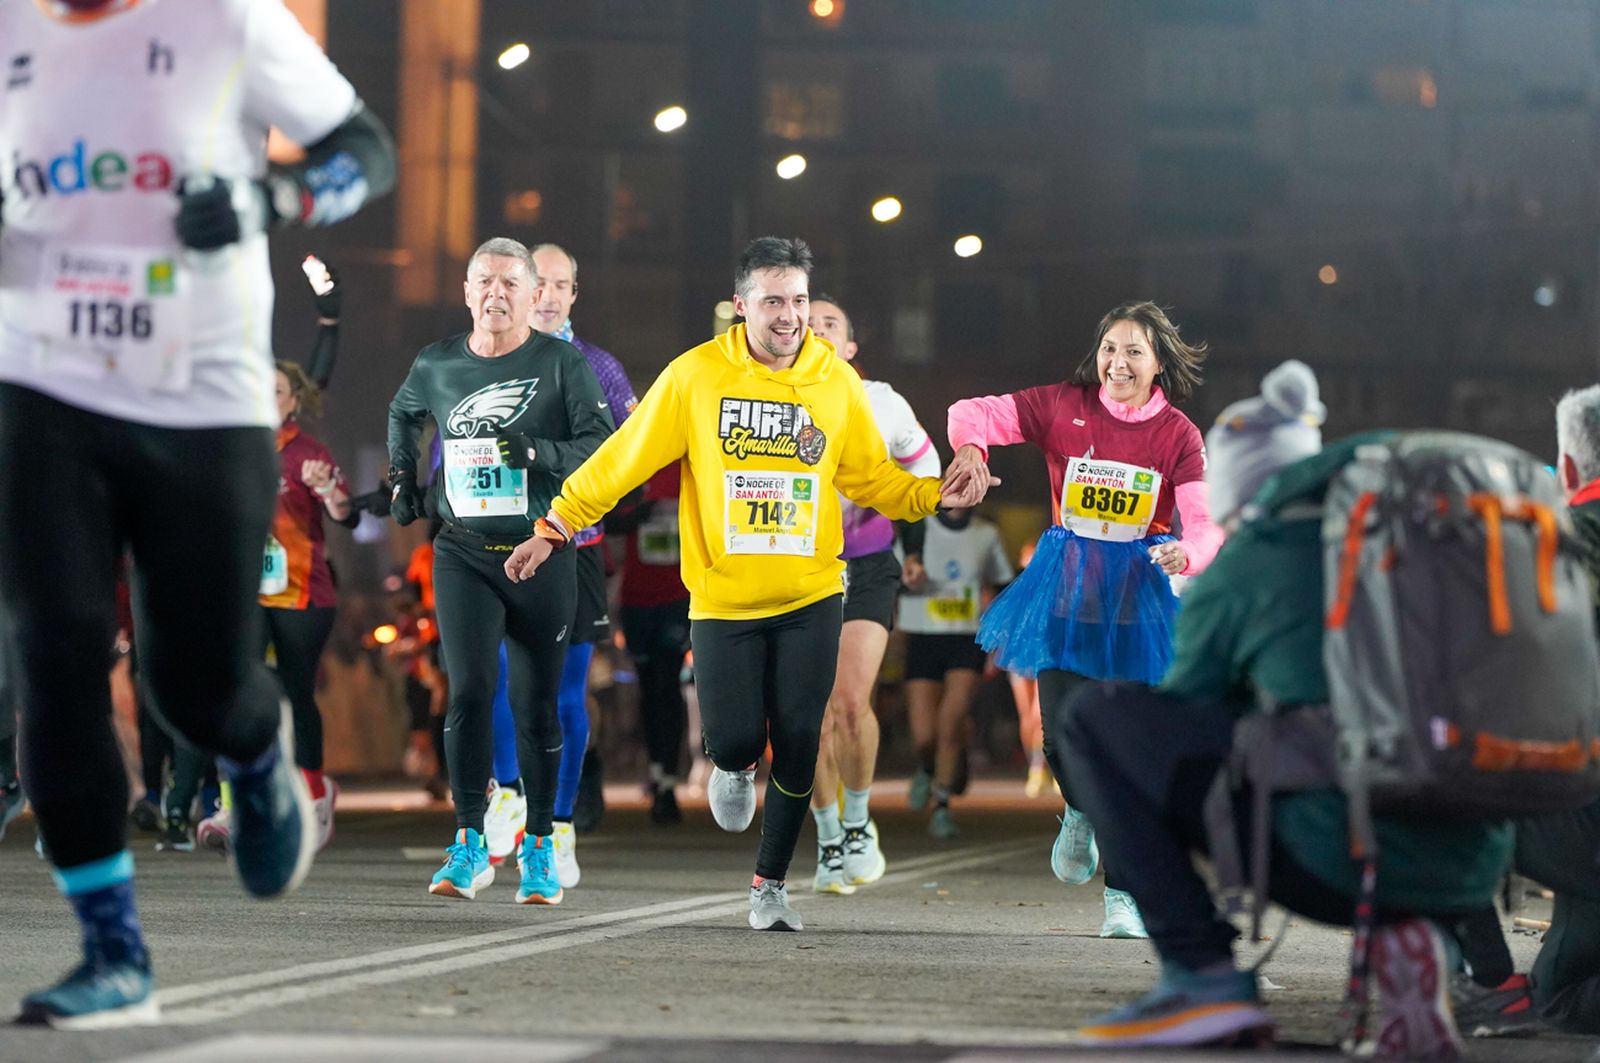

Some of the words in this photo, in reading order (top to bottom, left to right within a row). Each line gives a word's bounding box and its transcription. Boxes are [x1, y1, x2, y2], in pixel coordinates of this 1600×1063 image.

[70, 300, 154, 342] 1136
[722, 427, 798, 460] Amarilla
[1075, 474, 1093, 484] SAN
[1088, 468, 1114, 477] NOCHE
[1116, 470, 1127, 479] DE
[746, 480, 773, 489] NOCHE
[735, 490, 754, 499] SAN
[1081, 486, 1139, 516] 8367
[746, 501, 797, 526] 7142
